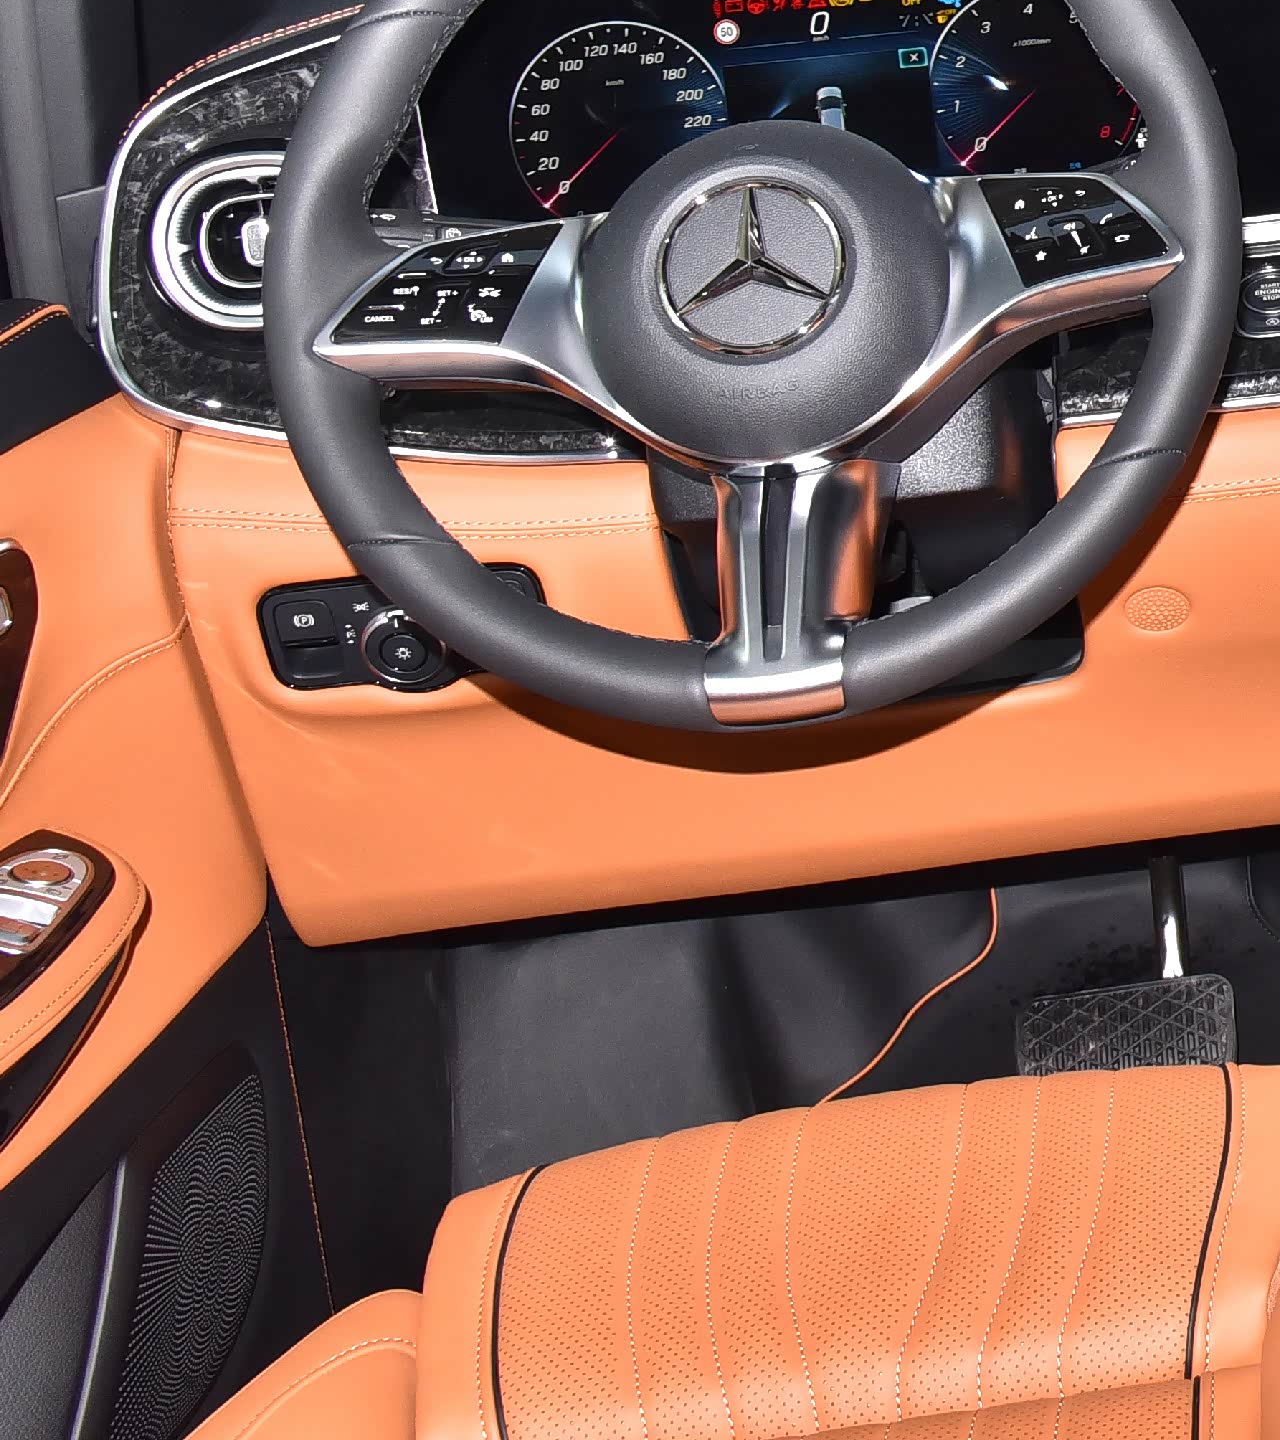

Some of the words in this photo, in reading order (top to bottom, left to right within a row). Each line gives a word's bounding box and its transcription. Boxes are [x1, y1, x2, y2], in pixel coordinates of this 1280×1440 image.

[1023, 3, 1033, 15] 4
[810, 11, 830, 35] 0
[1069, 12, 1079, 24] 5
[720, 27, 733, 37] 50
[980, 21, 991, 34] 3
[584, 44, 608, 58] 120
[613, 42, 638, 55] 140
[640, 52, 664, 65] 160
[955, 56, 966, 68] 2
[559, 60, 584, 73] 100
[662, 68, 687, 81] 180
[540, 78, 560, 90] 80
[676, 89, 704, 102] 200
[531, 104, 550, 116] 60
[953, 100, 961, 113] 1
[683, 115, 712, 128] 220
[530, 130, 549, 142] 40
[1100, 125, 1111, 139] 8
[975, 137, 987, 151] 0
[538, 157, 560, 171] 20
[559, 181, 571, 195] 0
[364, 315, 395, 323] CANCEL
